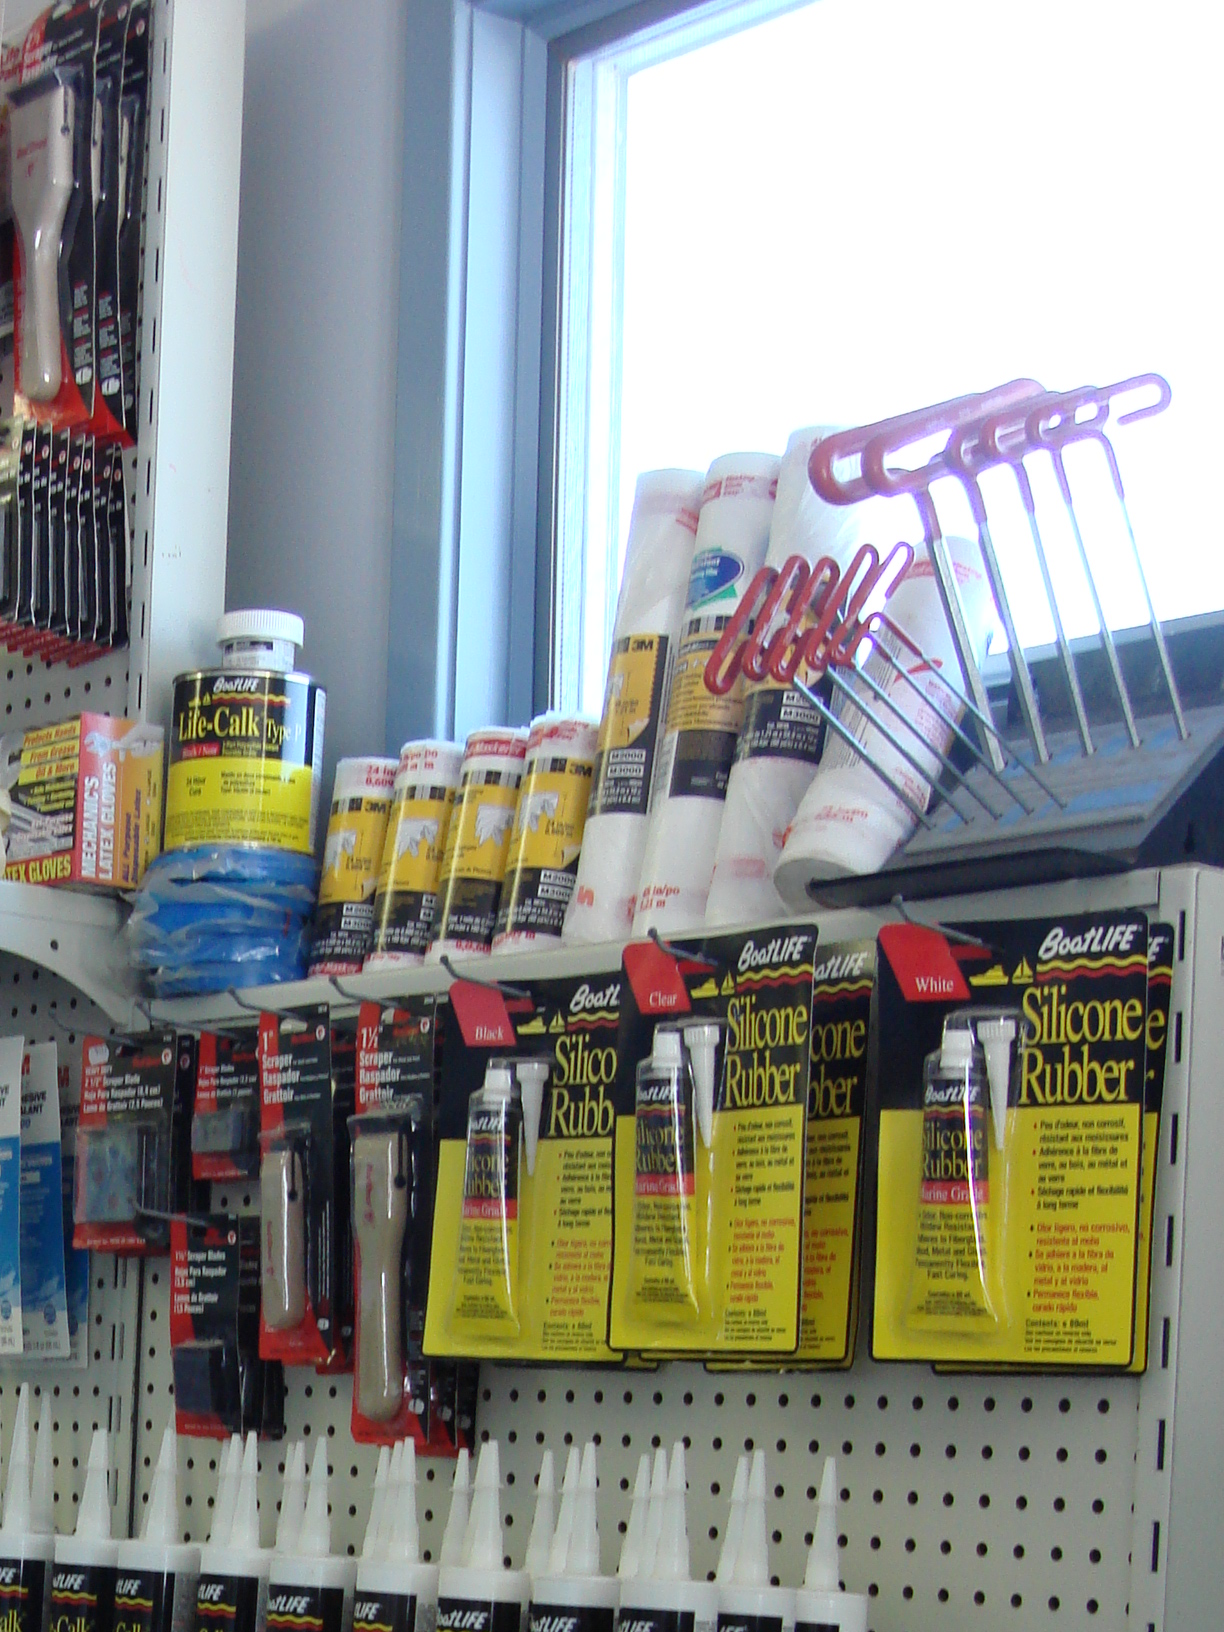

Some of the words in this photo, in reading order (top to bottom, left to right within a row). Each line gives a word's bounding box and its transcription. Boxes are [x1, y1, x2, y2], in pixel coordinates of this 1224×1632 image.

[632, 639, 654, 652] 3M
[213, 676, 260, 693] BoatLIFE
[179, 706, 261, 742] Life-Calk
[266, 718, 292, 739] Type
[294, 724, 303, 742] P
[30, 749, 49, 764] From
[569, 763, 593, 777] 3M
[100, 761, 117, 825] GLOVES
[364, 803, 387, 814] 3M
[98, 829, 115, 881] LATEX
[28, 855, 72, 884] GLOVES
[1038, 924, 1138, 960] BoatLIFE
[736, 935, 809, 972] BoatLIFE
[915, 976, 954, 995] White
[648, 990, 677, 1008] Clear
[727, 994, 809, 1052] Silicone
[1022, 984, 1144, 1046] Silicone
[262, 1029, 275, 1052] 1"
[474, 1025, 505, 1042] Black
[262, 1053, 294, 1070] Scraper
[359, 1050, 394, 1070] Scraper
[262, 1069, 301, 1087] Raspador
[359, 1067, 402, 1085] Raspador
[726, 1050, 801, 1108] Rubber
[1019, 1044, 1135, 1106] Rubber
[262, 1085, 295, 1105] Grattoir
[359, 1085, 395, 1104] Grattoir
